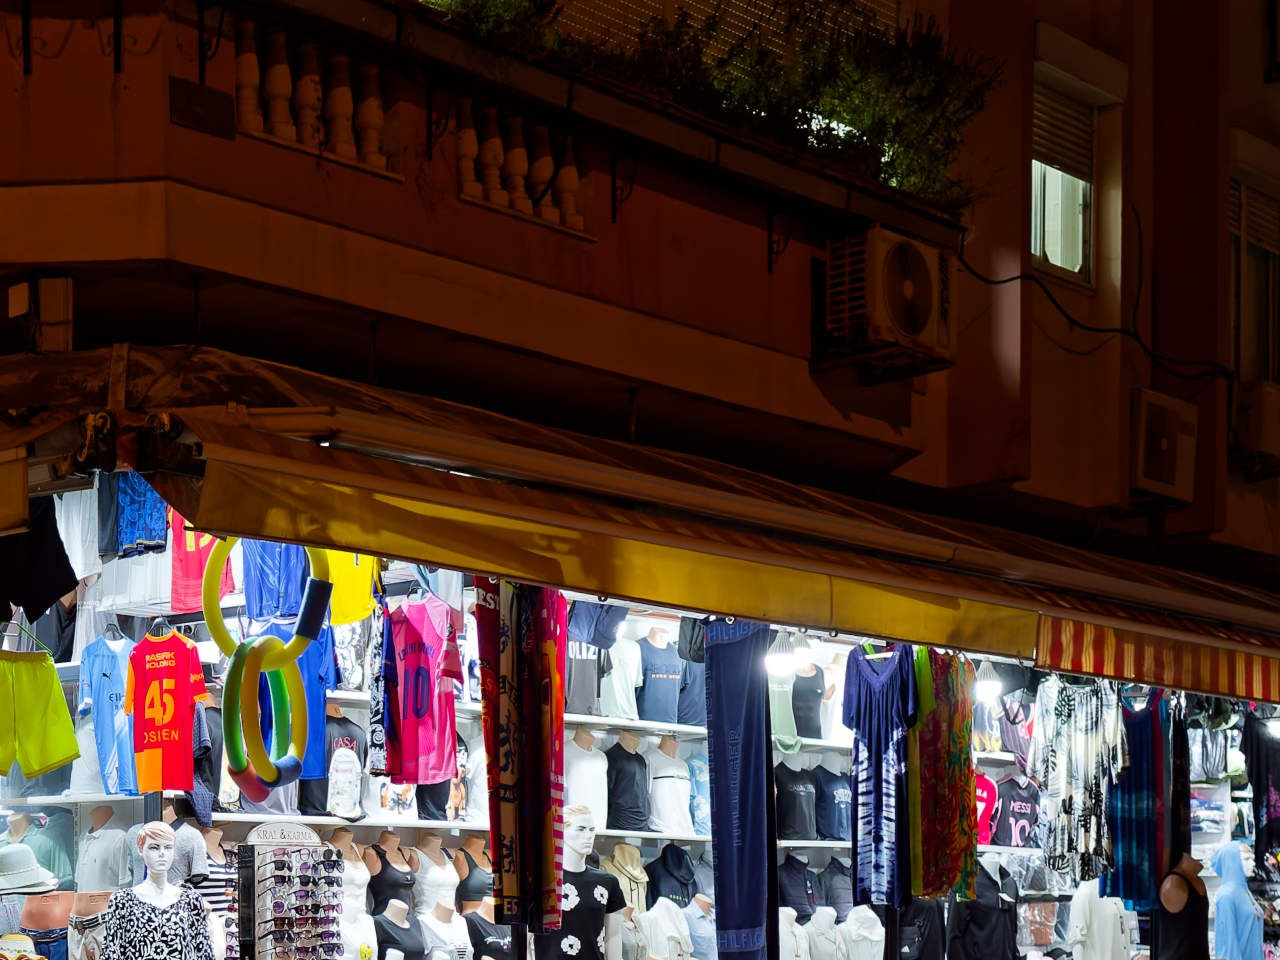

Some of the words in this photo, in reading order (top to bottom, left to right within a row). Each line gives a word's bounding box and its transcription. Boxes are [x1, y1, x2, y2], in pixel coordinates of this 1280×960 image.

[144, 678, 176, 727] 45
[402, 665, 431, 720] 10
[1010, 800, 1032, 815] MESSI
[279, 828, 287, 840] &
[1009, 816, 1031, 847] 10
